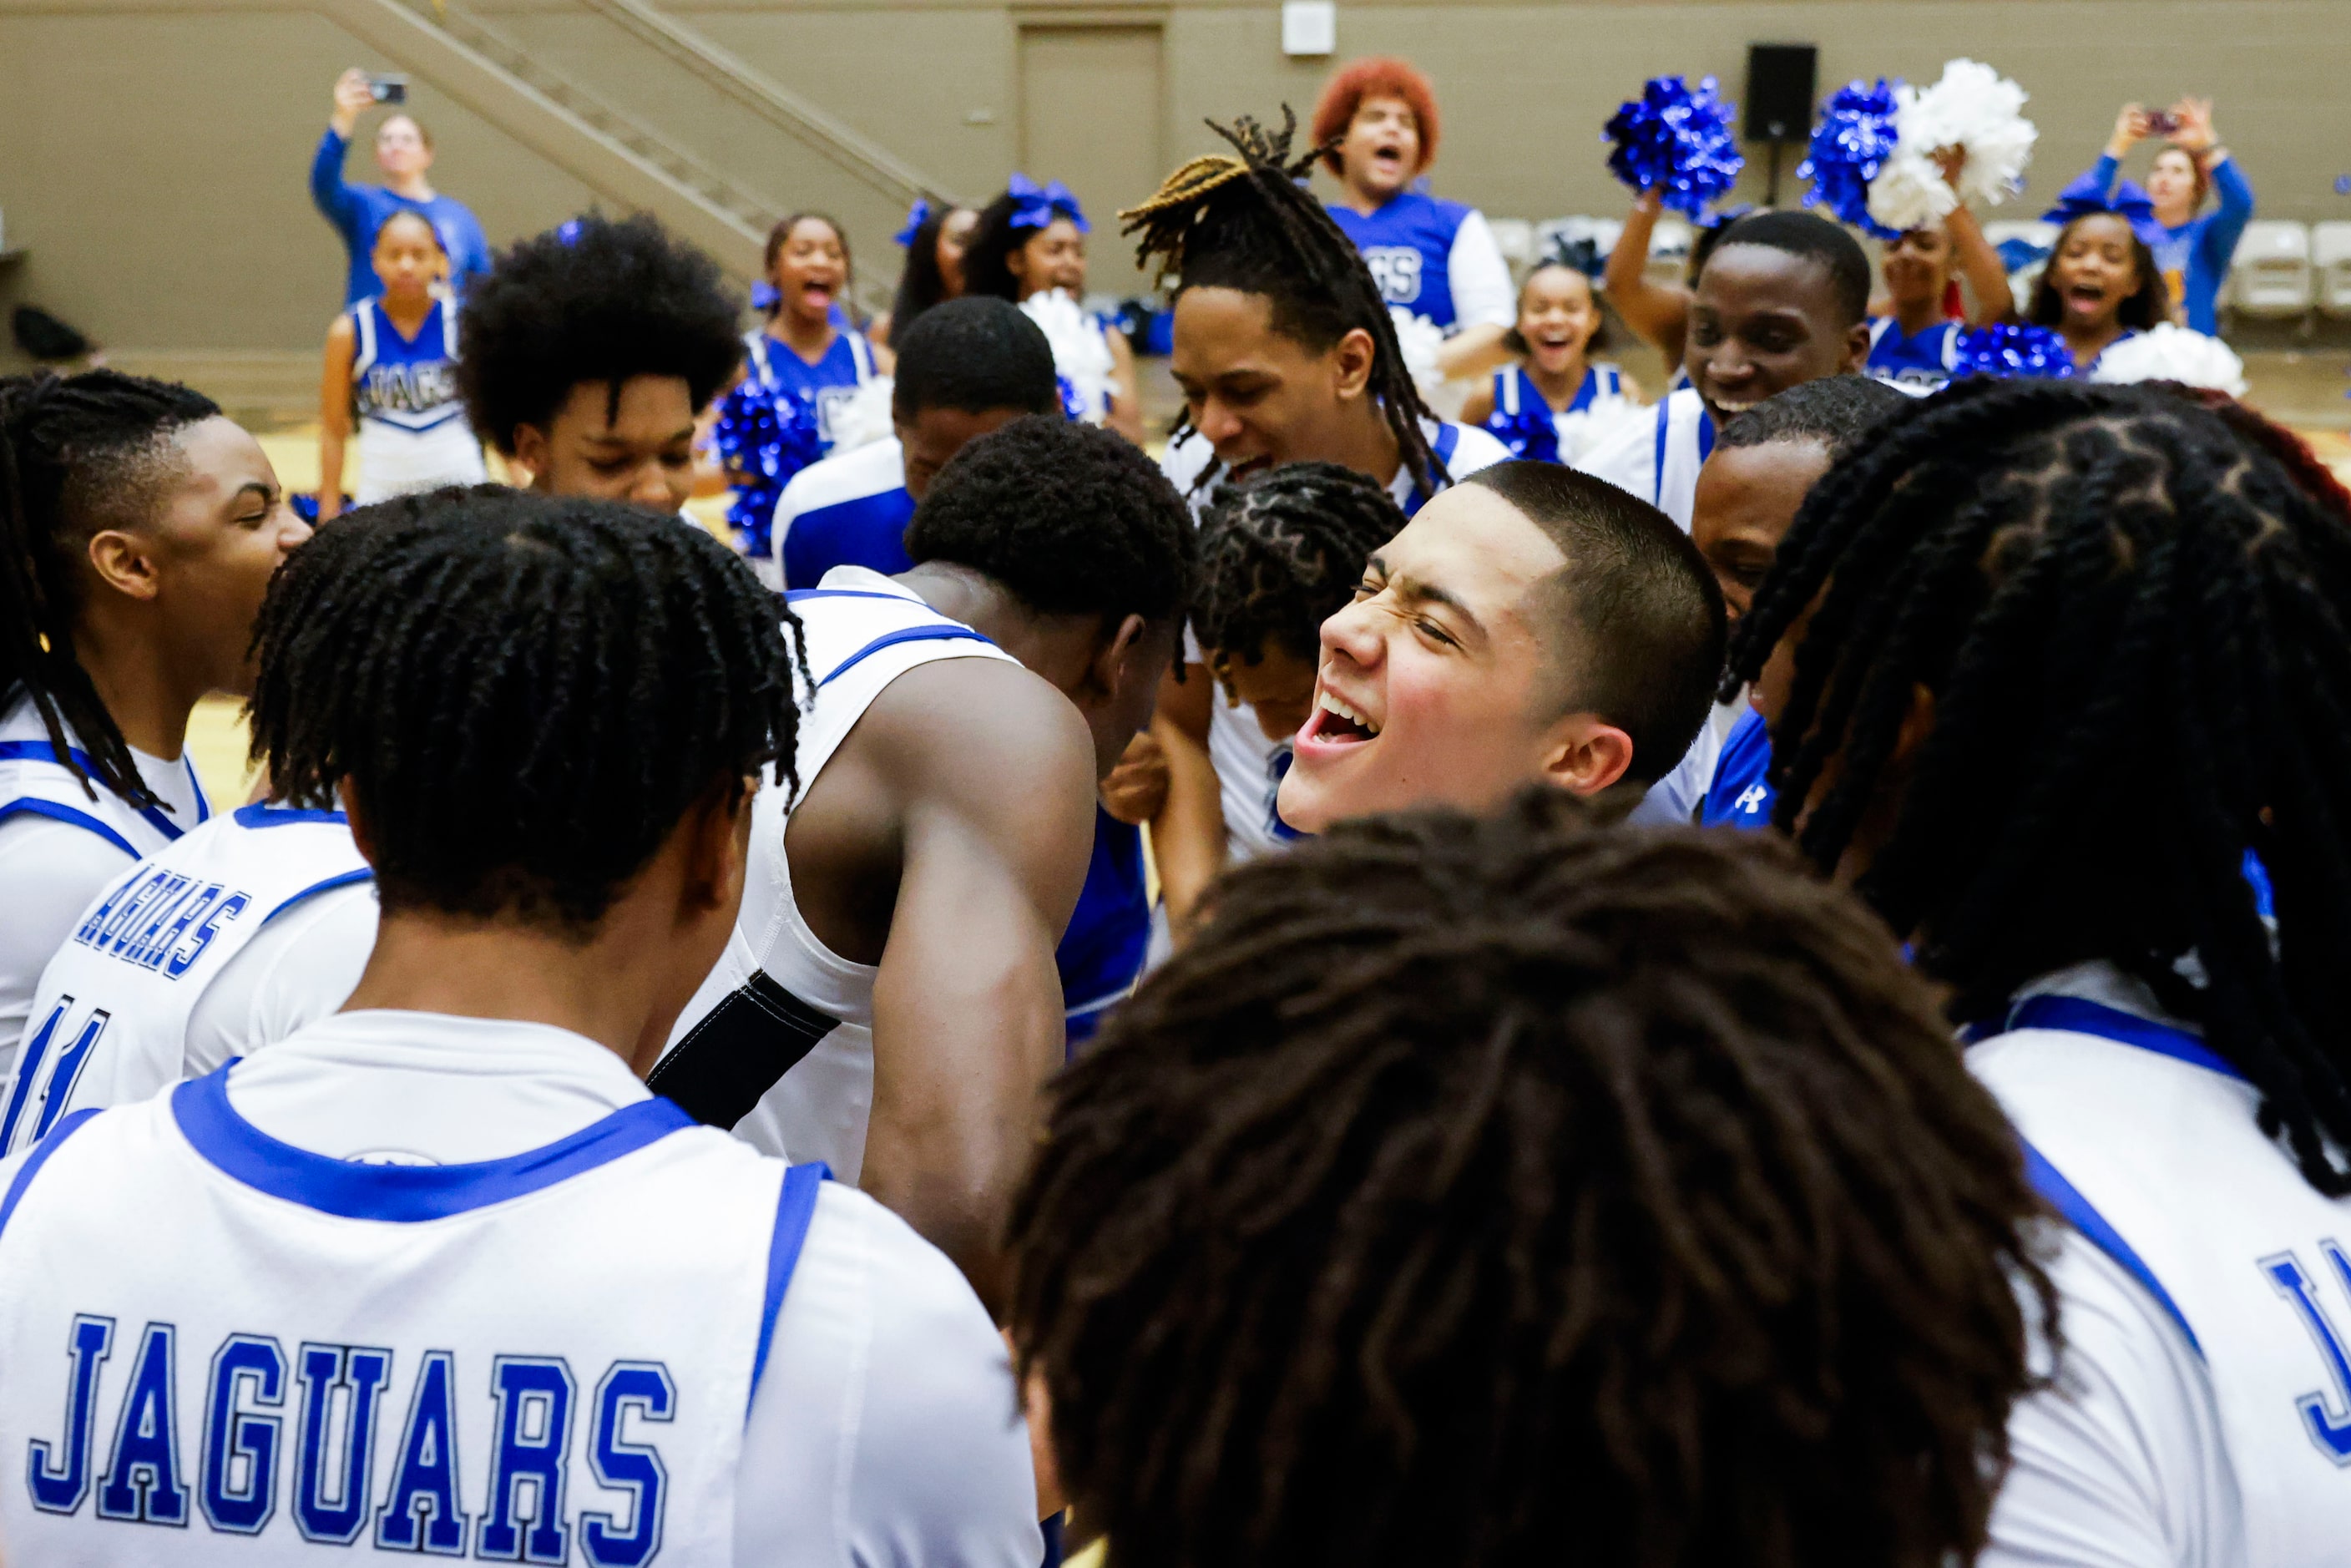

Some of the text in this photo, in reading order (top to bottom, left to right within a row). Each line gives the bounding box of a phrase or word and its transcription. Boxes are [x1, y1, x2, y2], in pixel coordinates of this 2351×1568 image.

[0, 994, 111, 1161] 11
[25, 1313, 677, 1568] JAGUARS
[2255, 1237, 2351, 1468] J
